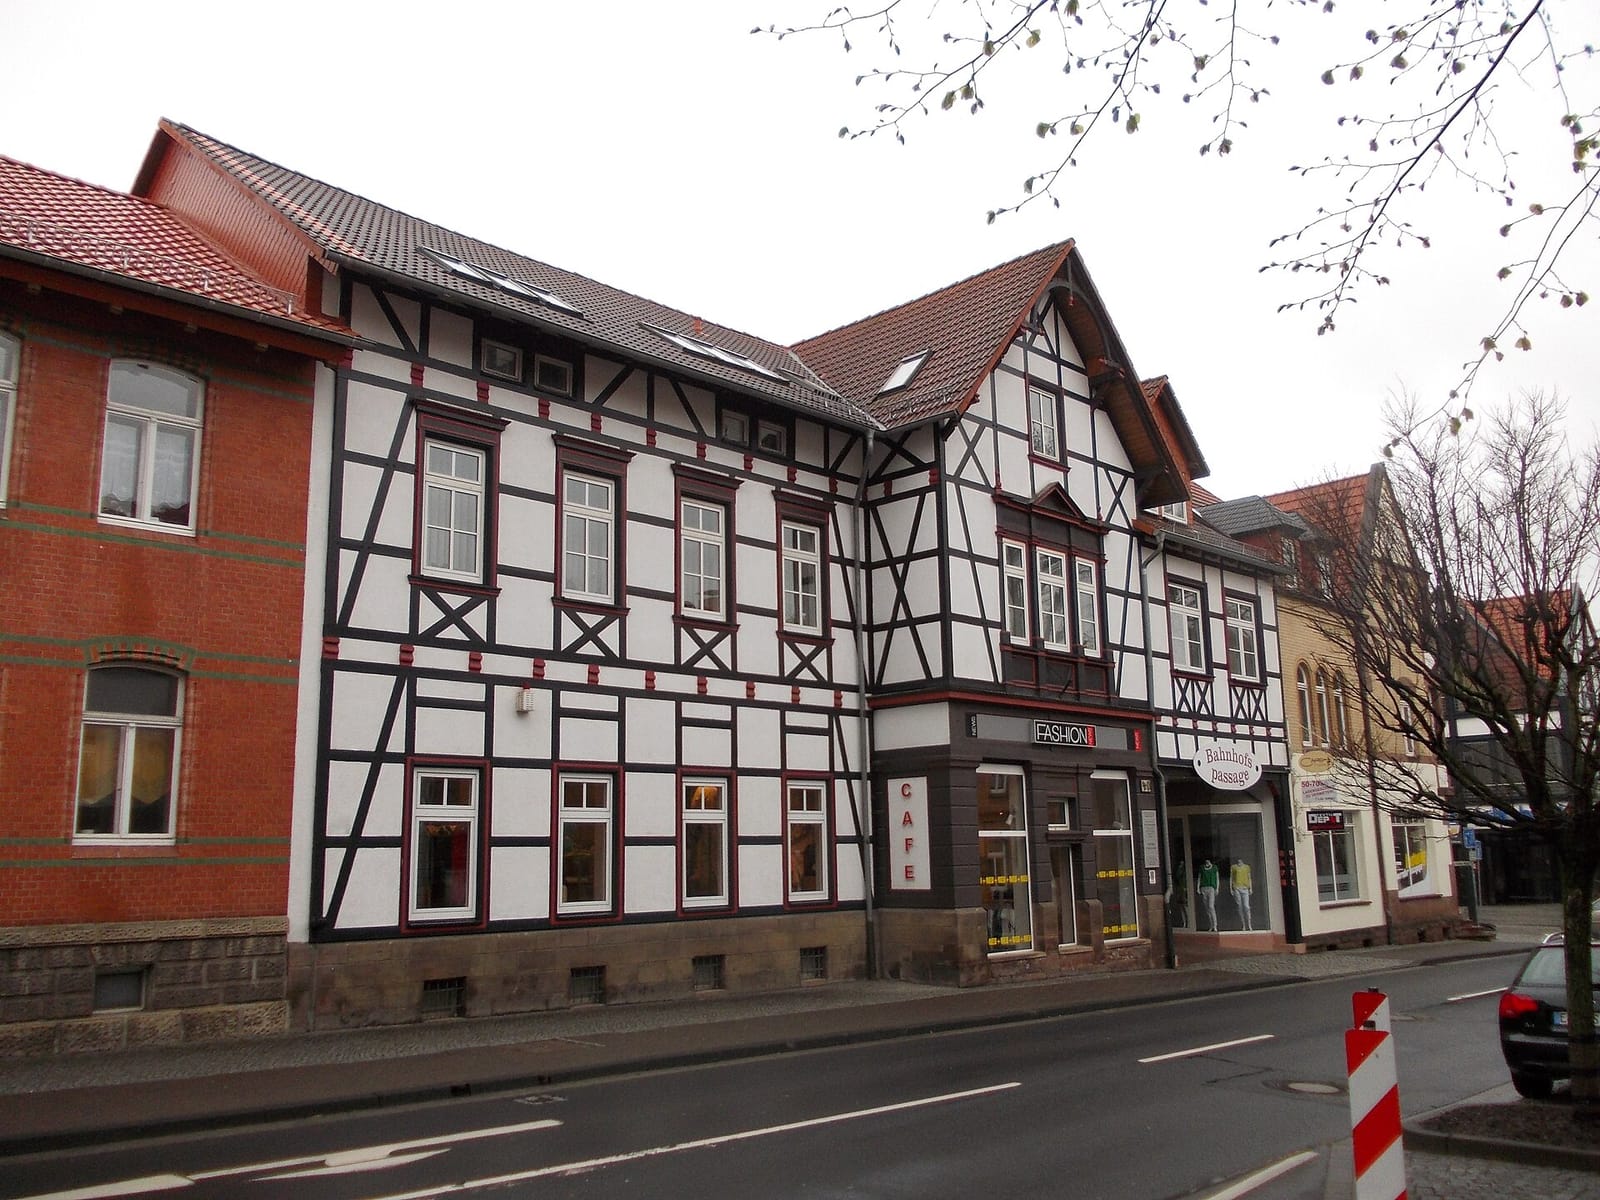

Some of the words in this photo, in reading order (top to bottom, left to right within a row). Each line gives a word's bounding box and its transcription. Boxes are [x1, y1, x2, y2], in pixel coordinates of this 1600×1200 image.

[1035, 723, 1088, 745] FASHION
[1205, 747, 1253, 769] Bahnhofs
[1211, 768, 1250, 787] passage
[901, 783, 915, 880] CAFE
